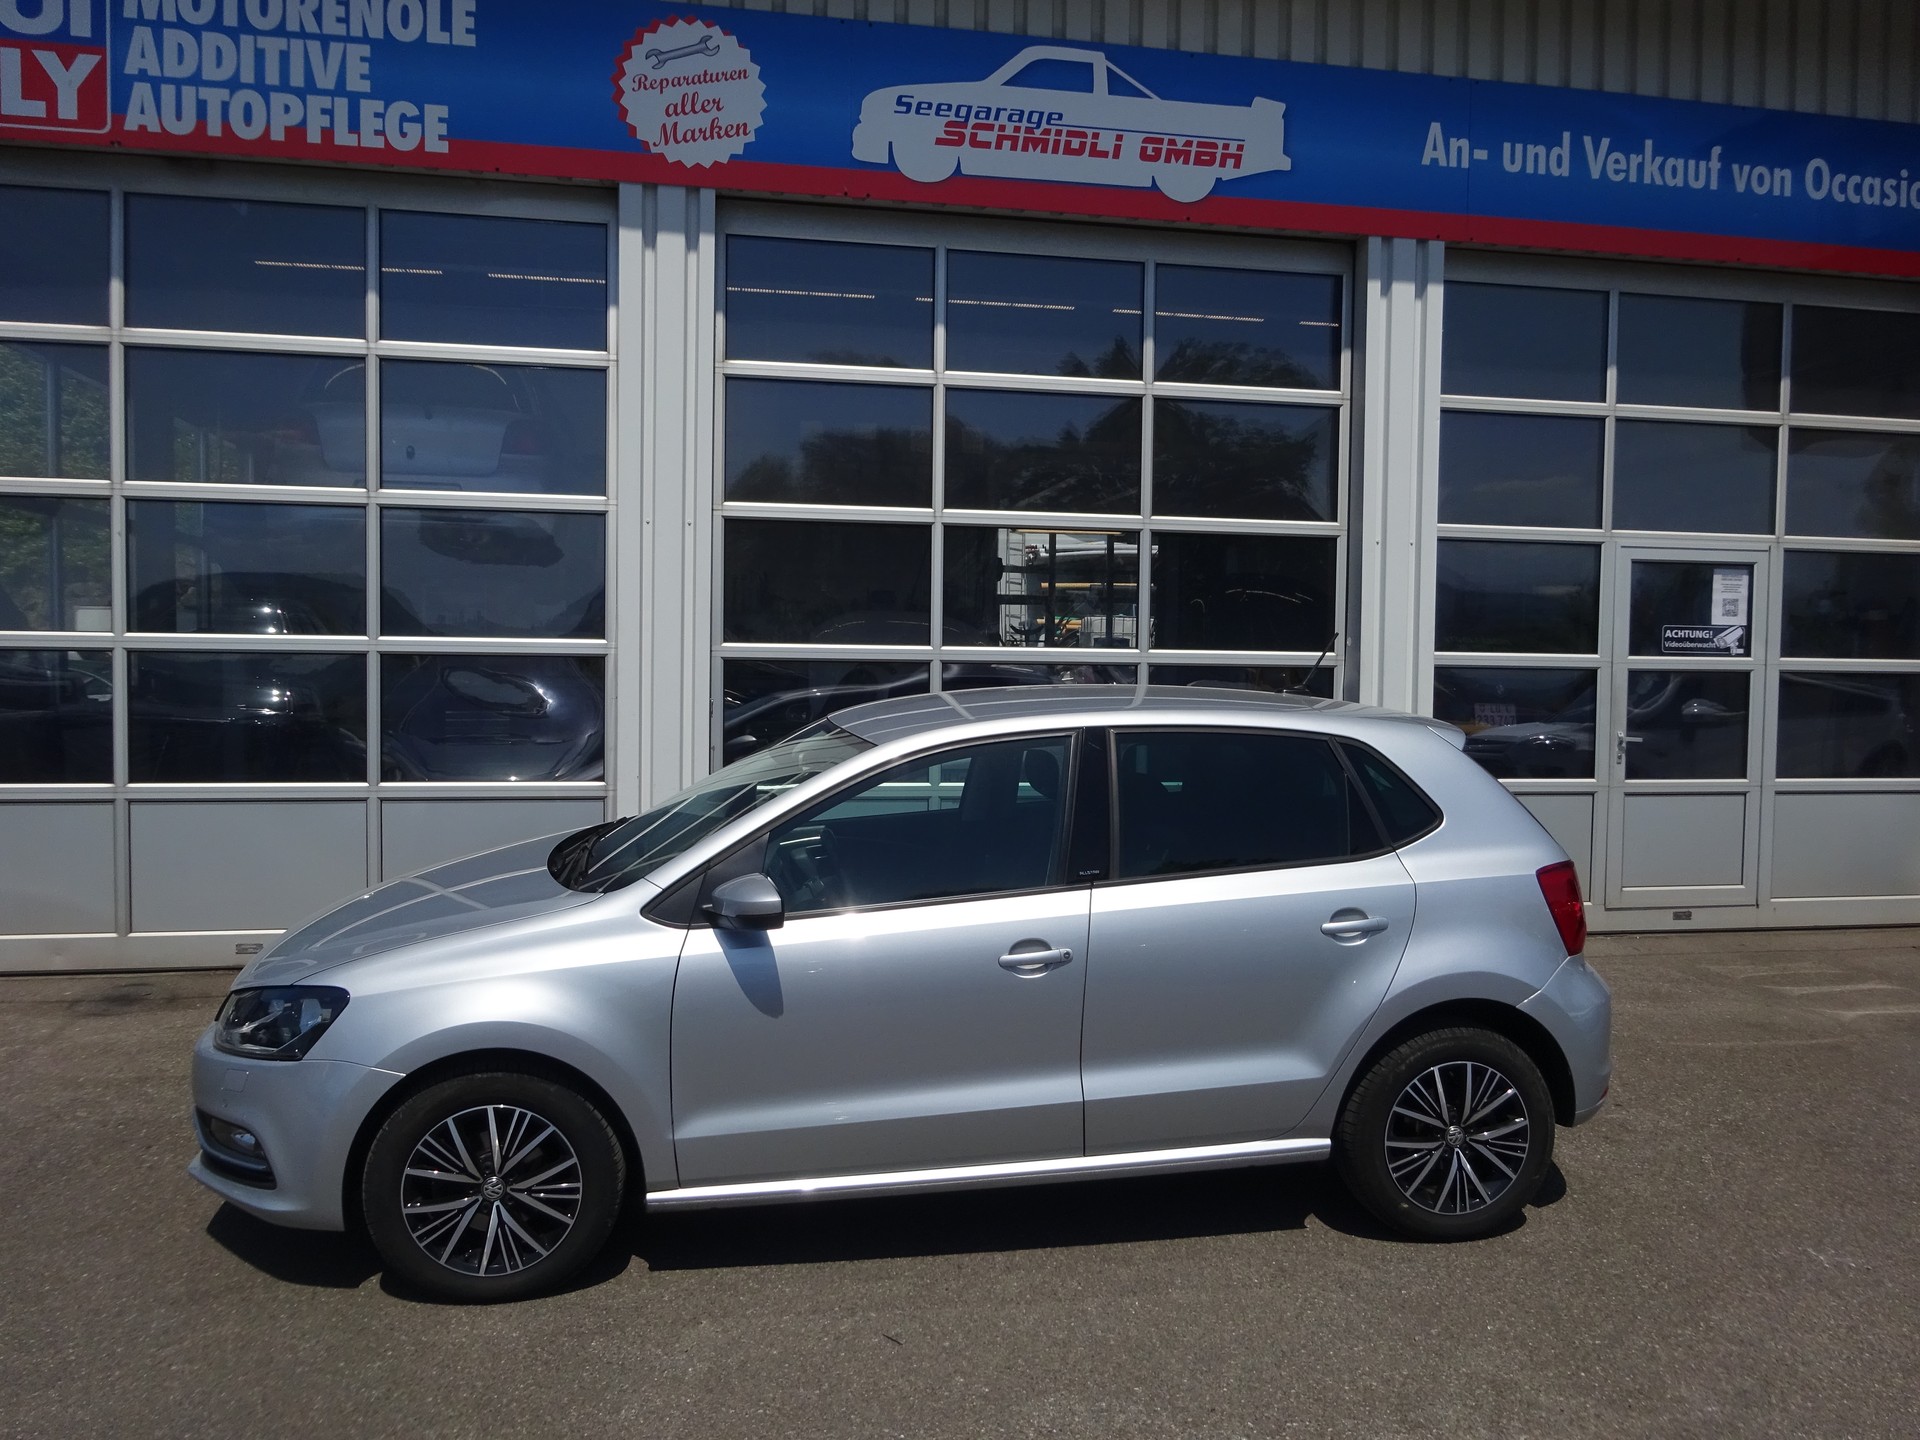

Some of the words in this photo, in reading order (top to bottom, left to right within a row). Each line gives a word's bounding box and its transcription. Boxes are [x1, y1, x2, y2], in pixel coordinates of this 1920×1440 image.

[123, 25, 371, 93] ADDITIVE
[632, 68, 749, 94] Reparaturen
[123, 82, 449, 154] AUTOPFLEGE
[665, 91, 724, 117] aller
[893, 95, 1064, 129] Seegarage
[653, 117, 751, 147] Marken
[934, 121, 1124, 160] SCHMIDLI
[1139, 136, 1245, 170] GMBH
[1421, 122, 1488, 168] An-
[1503, 131, 1570, 177] und
[1583, 135, 1722, 190] Verkauf
[1732, 163, 1792, 197] von
[1664, 629, 1713, 639] ACHTUNG!
